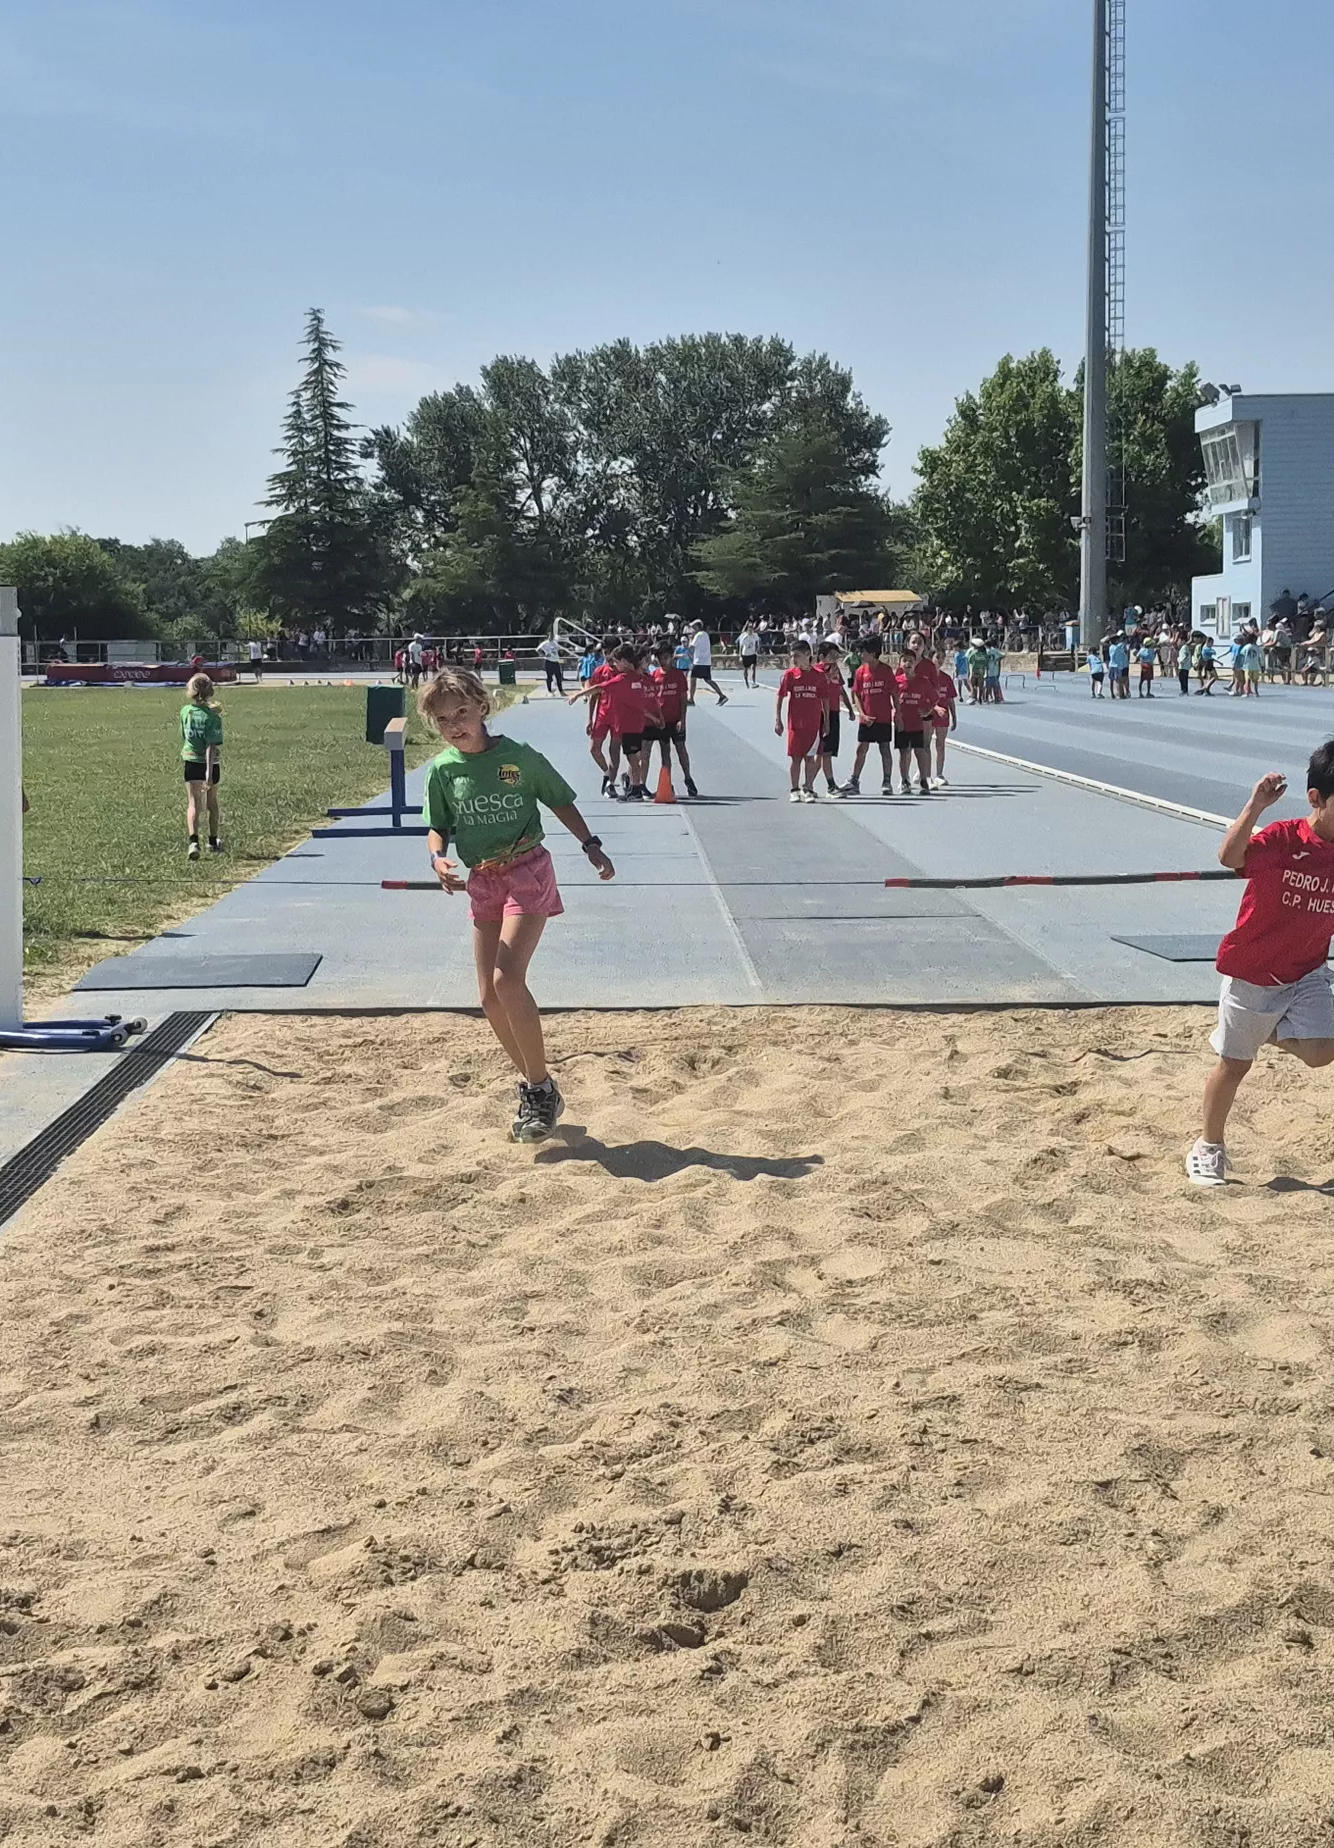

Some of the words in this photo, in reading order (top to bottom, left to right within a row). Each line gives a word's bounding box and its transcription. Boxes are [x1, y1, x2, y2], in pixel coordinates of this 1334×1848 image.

[1281, 869, 1320, 892] PEDRO
[1320, 877, 1329, 893] J.
[1282, 891, 1302, 909] C.P.
